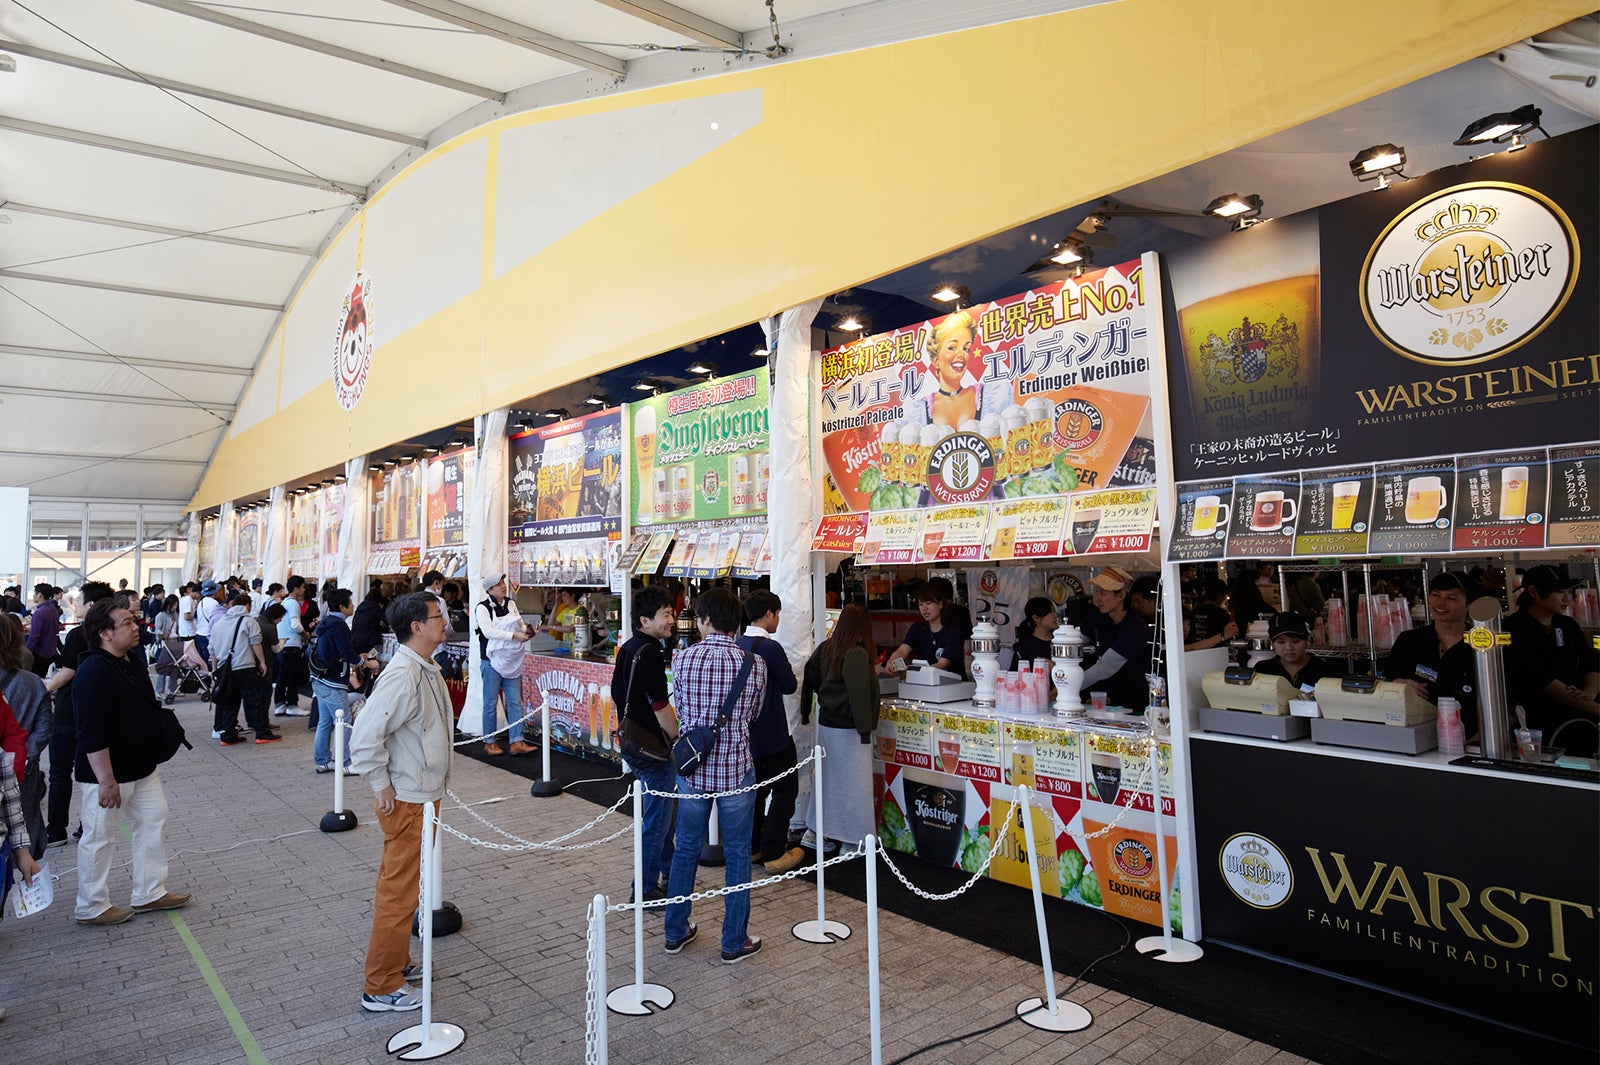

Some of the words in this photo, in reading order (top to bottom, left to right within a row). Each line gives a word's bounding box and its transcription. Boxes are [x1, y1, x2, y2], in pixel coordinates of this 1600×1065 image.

[1378, 243, 1552, 309] Warsteiner
[980, 266, 1146, 345] 世界売上No.1
[1446, 307, 1487, 327] 1753
[983, 317, 1148, 384] エルディンガー
[1019, 370, 1078, 395] Erdinger
[1203, 391, 1245, 414] König
[1247, 382, 1309, 412] Ludwig
[1357, 403, 1484, 426] FAMILIENTRADITION
[930, 436, 990, 469] ERDINGER
[536, 453, 620, 499] 横浜ビール
[934, 477, 990, 504] WEISSBRÄU
[820, 524, 866, 536] ビールレジ
[822, 539, 852, 548] cashier
[1026, 542, 1048, 554] ¥800
[536, 669, 585, 705] YOKOHAMA
[1048, 779, 1072, 794] ¥800
[914, 799, 959, 824] Köstritzer
[1114, 840, 1152, 860] ERDINGER
[1226, 855, 1286, 886] Warsteiner
[1108, 880, 1161, 904] ERDINGER
[1307, 908, 1593, 996] FAMILIENTRADITION
